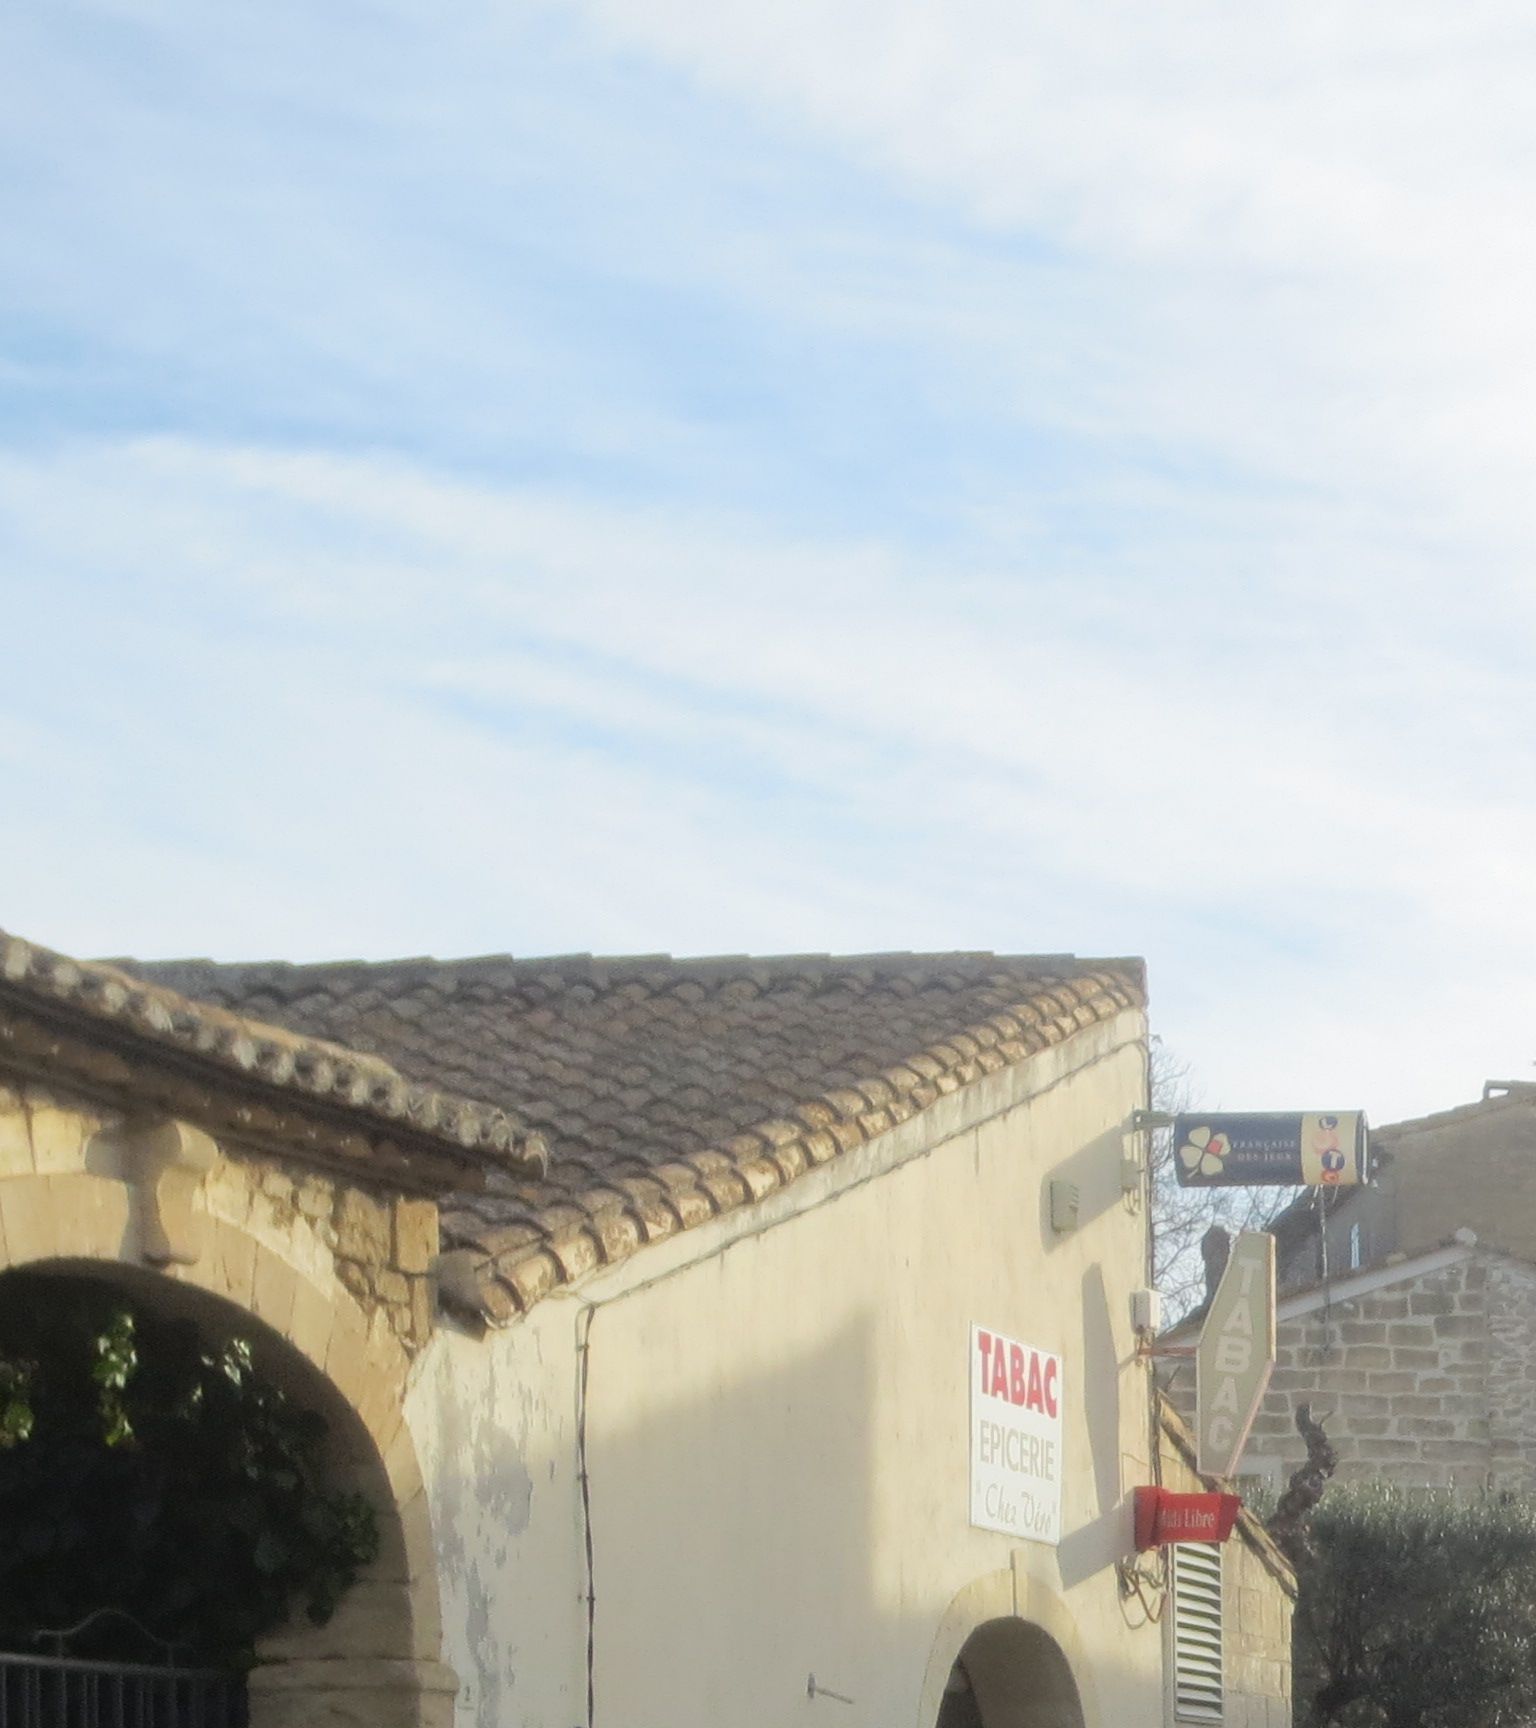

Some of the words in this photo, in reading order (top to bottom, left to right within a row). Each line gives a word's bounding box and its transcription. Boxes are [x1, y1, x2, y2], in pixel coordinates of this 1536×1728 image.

[1237, 1152, 1259, 1161] DES
[1264, 1152, 1293, 1161] JEUX
[978, 1331, 1058, 1420] TABAC
[1208, 1257, 1262, 1451] TABAC
[980, 1420, 1055, 1481] EPICERIE
[1184, 1508, 1215, 1529] Libre
